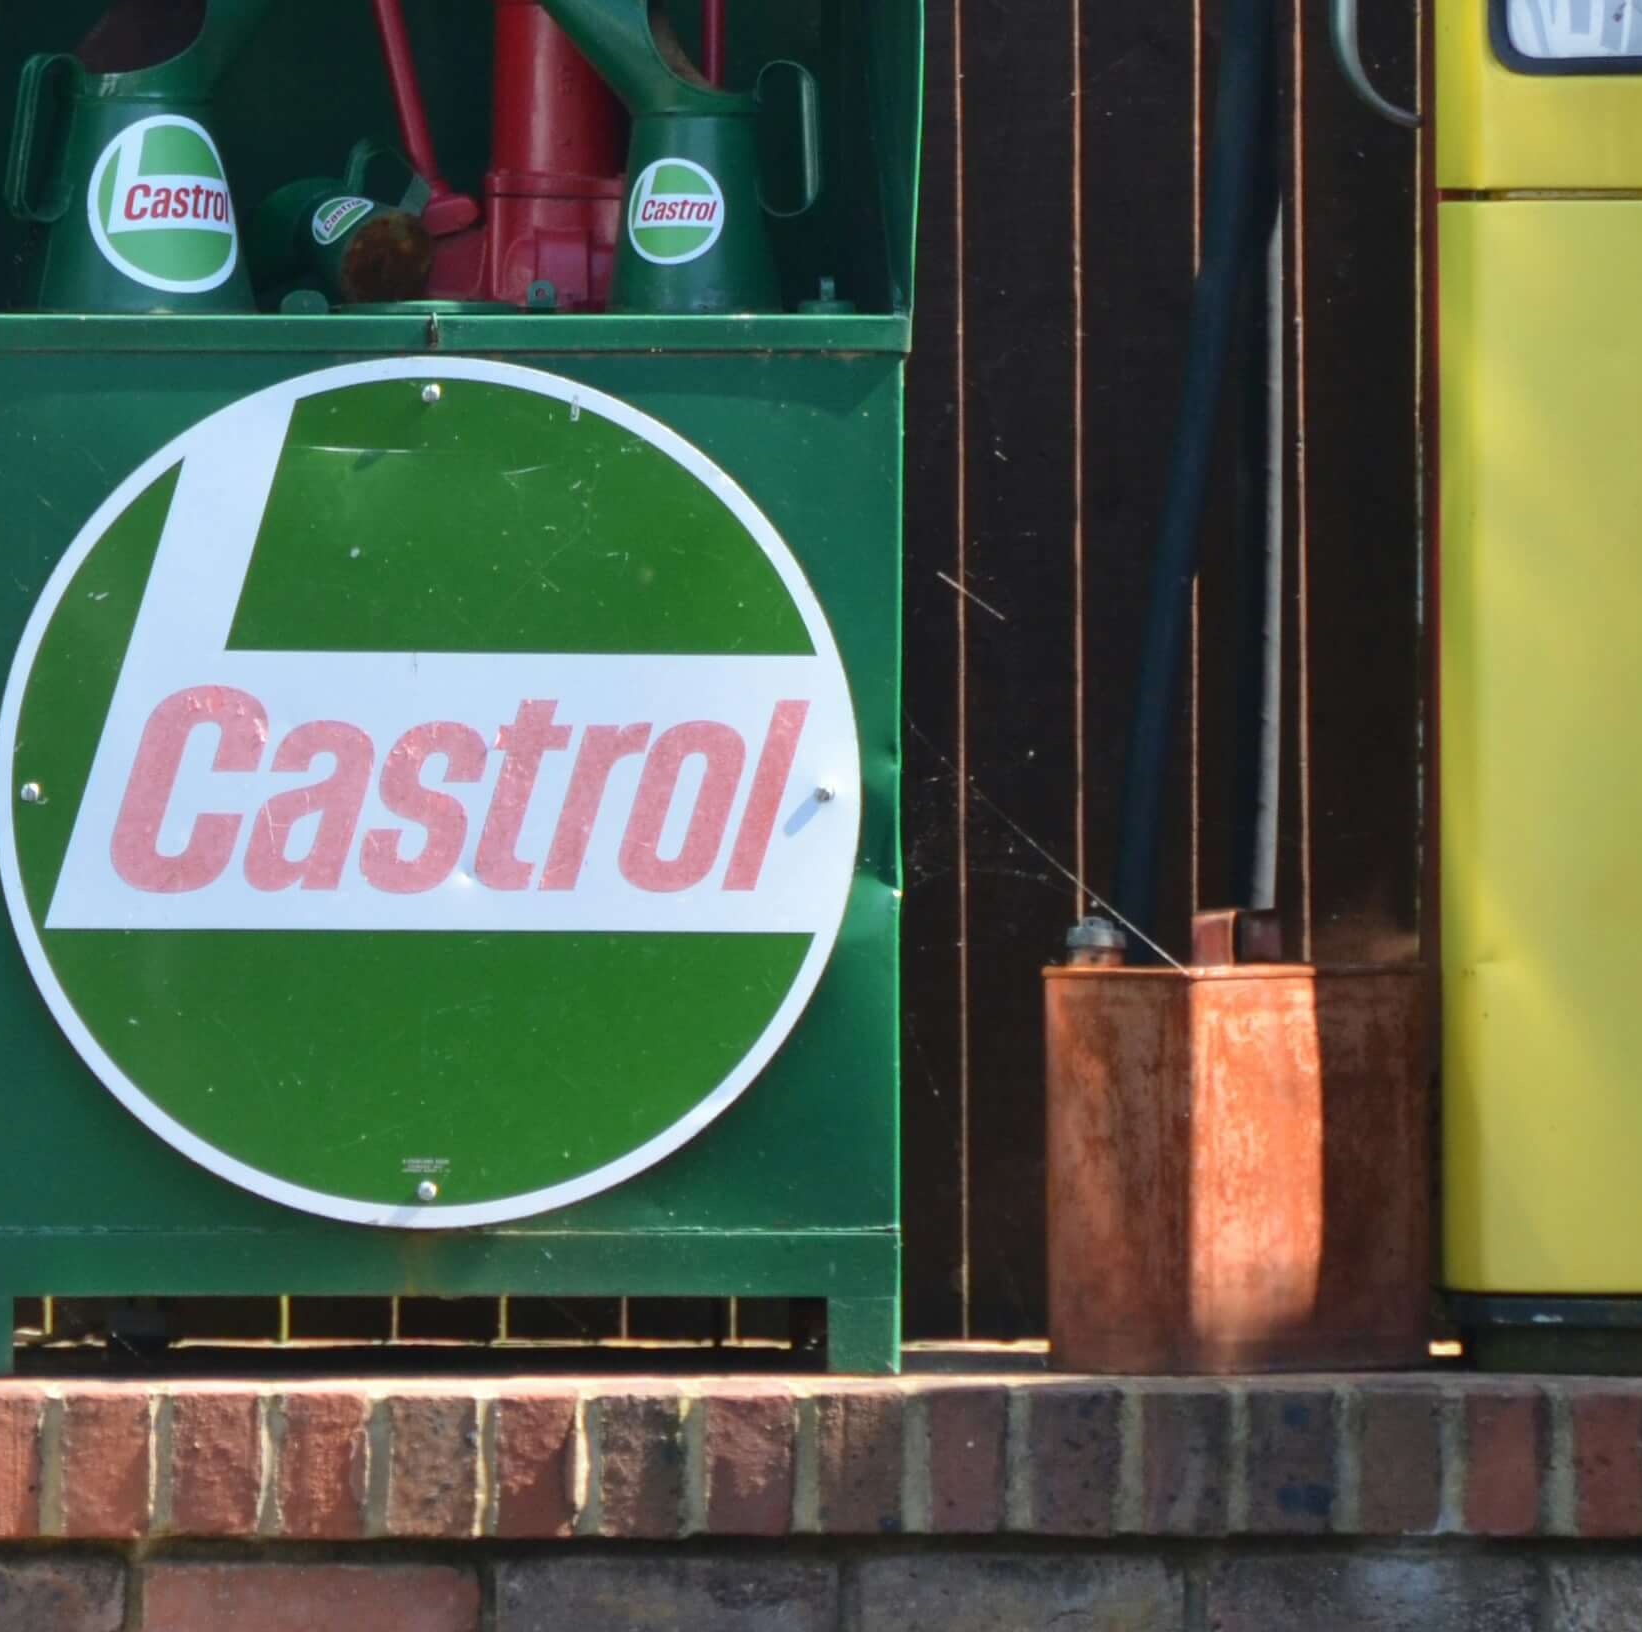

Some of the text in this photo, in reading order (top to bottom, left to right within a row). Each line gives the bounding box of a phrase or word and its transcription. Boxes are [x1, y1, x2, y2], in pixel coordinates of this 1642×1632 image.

[123, 183, 230, 224] Castrol
[641, 198, 717, 222] Castrol
[108, 684, 811, 896] Castrol
